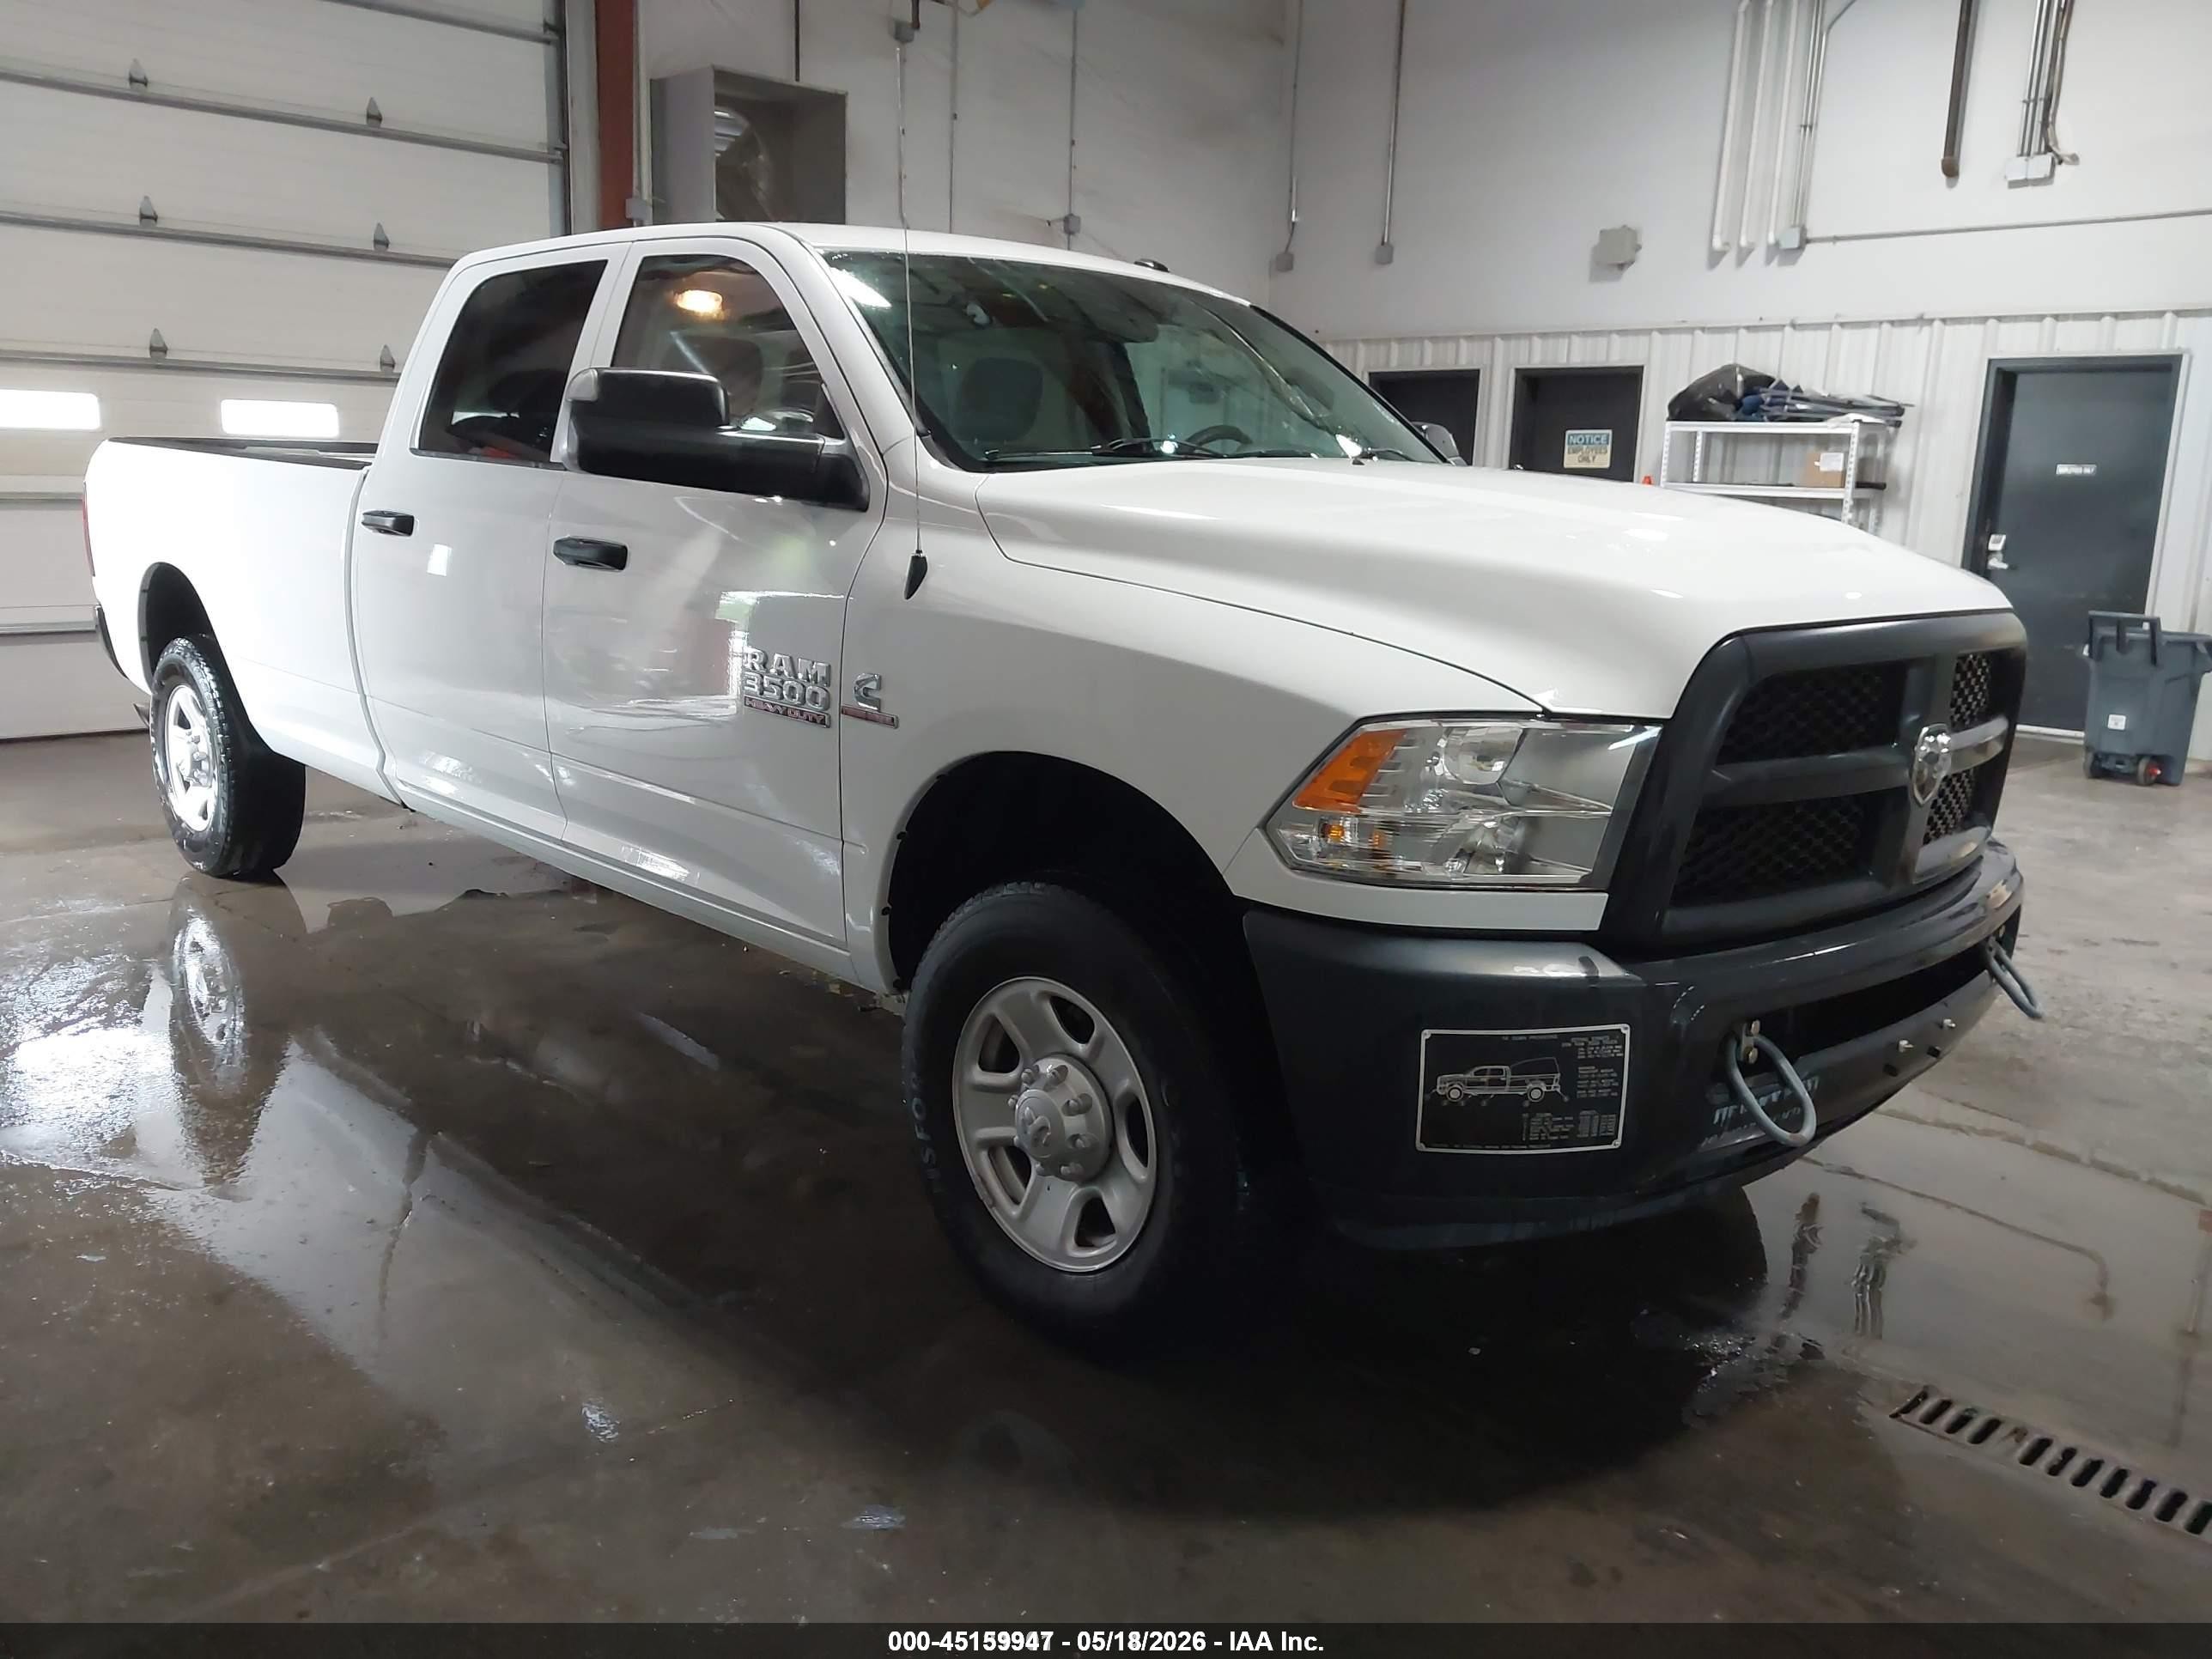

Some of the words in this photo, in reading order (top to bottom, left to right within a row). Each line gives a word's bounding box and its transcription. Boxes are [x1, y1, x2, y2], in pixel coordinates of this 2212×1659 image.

[1568, 434, 1607, 445] NOTICE
[743, 646, 831, 687] RAM
[743, 671, 830, 712] 3500
[744, 696, 786, 716] HEAVY
[787, 708, 826, 724] DUTY
